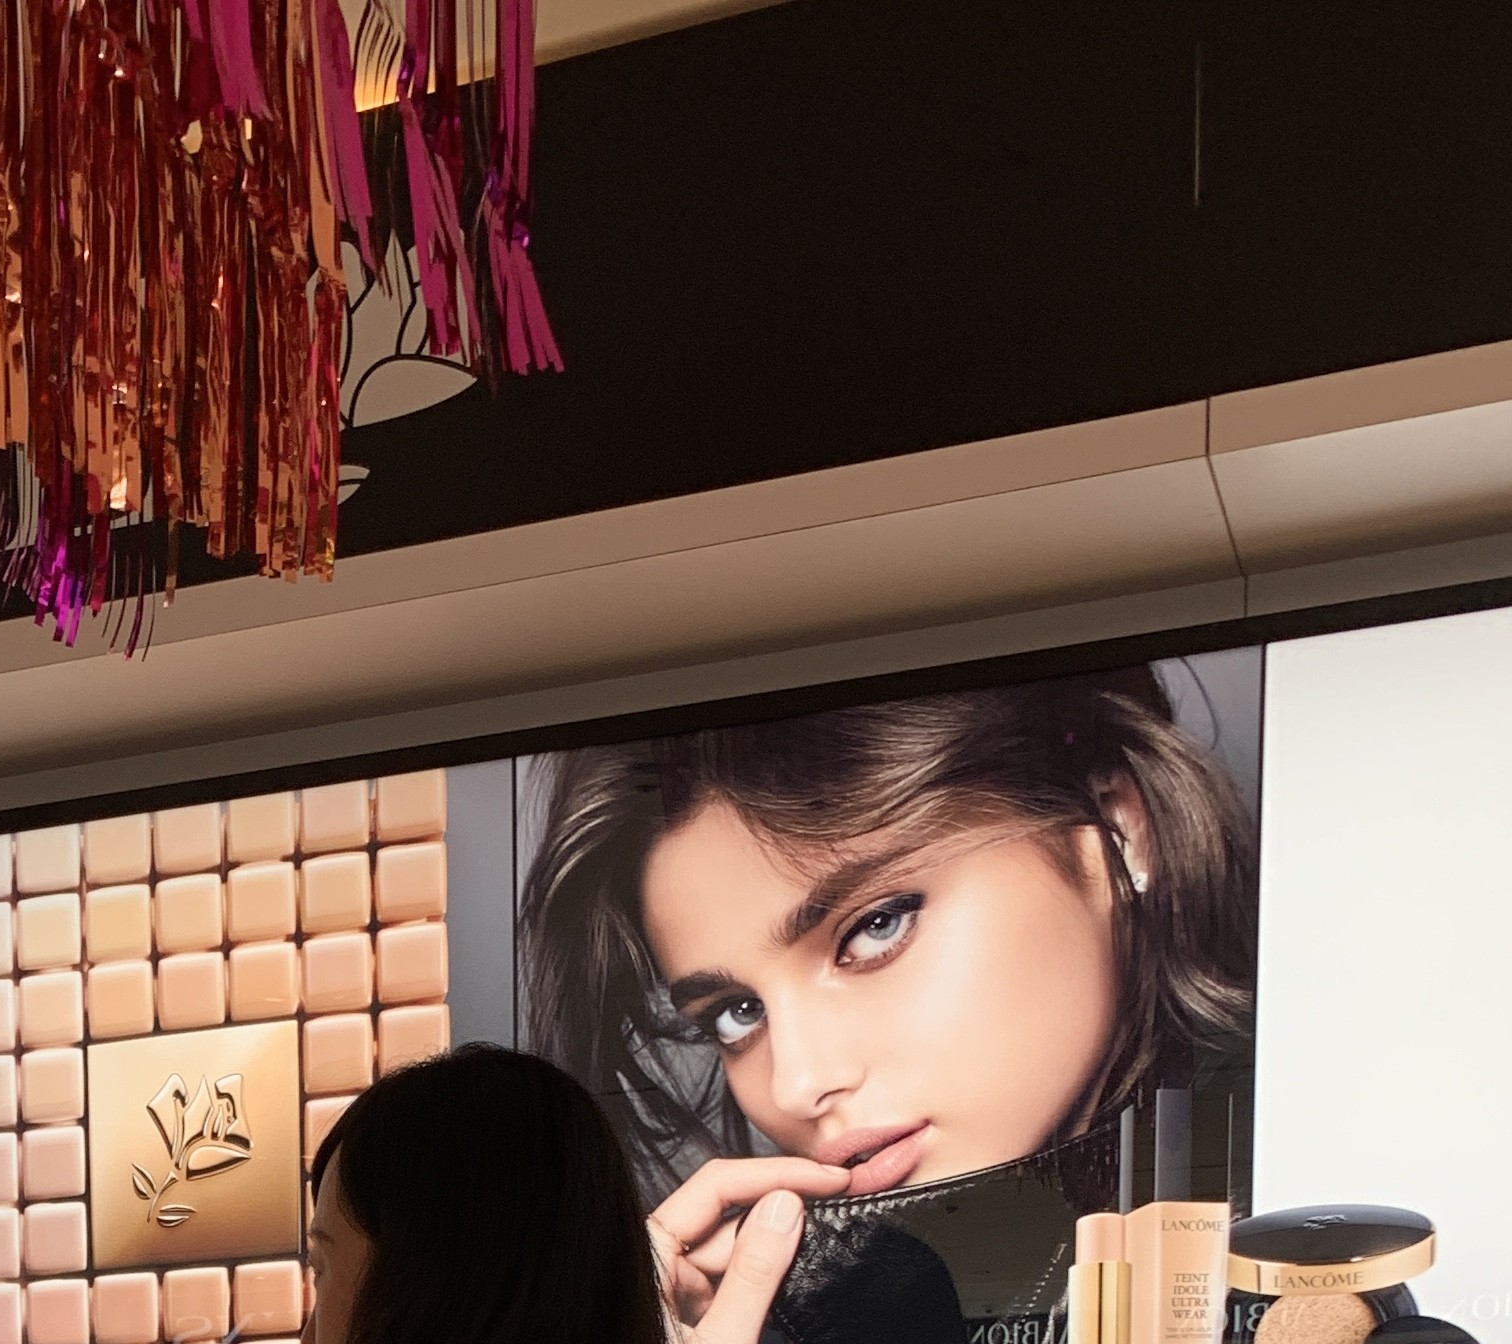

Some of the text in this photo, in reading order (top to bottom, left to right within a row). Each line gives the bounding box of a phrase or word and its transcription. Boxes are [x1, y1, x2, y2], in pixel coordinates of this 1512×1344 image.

[1161, 1219, 1225, 1233] LANCÔME
[1173, 1273, 1209, 1283] TEINT
[1273, 1271, 1365, 1289] LANCÔME
[1173, 1285, 1209, 1295] IDOLE
[1172, 1297, 1209, 1308] ULTRA
[1172, 1309, 1207, 1320] WEAR
